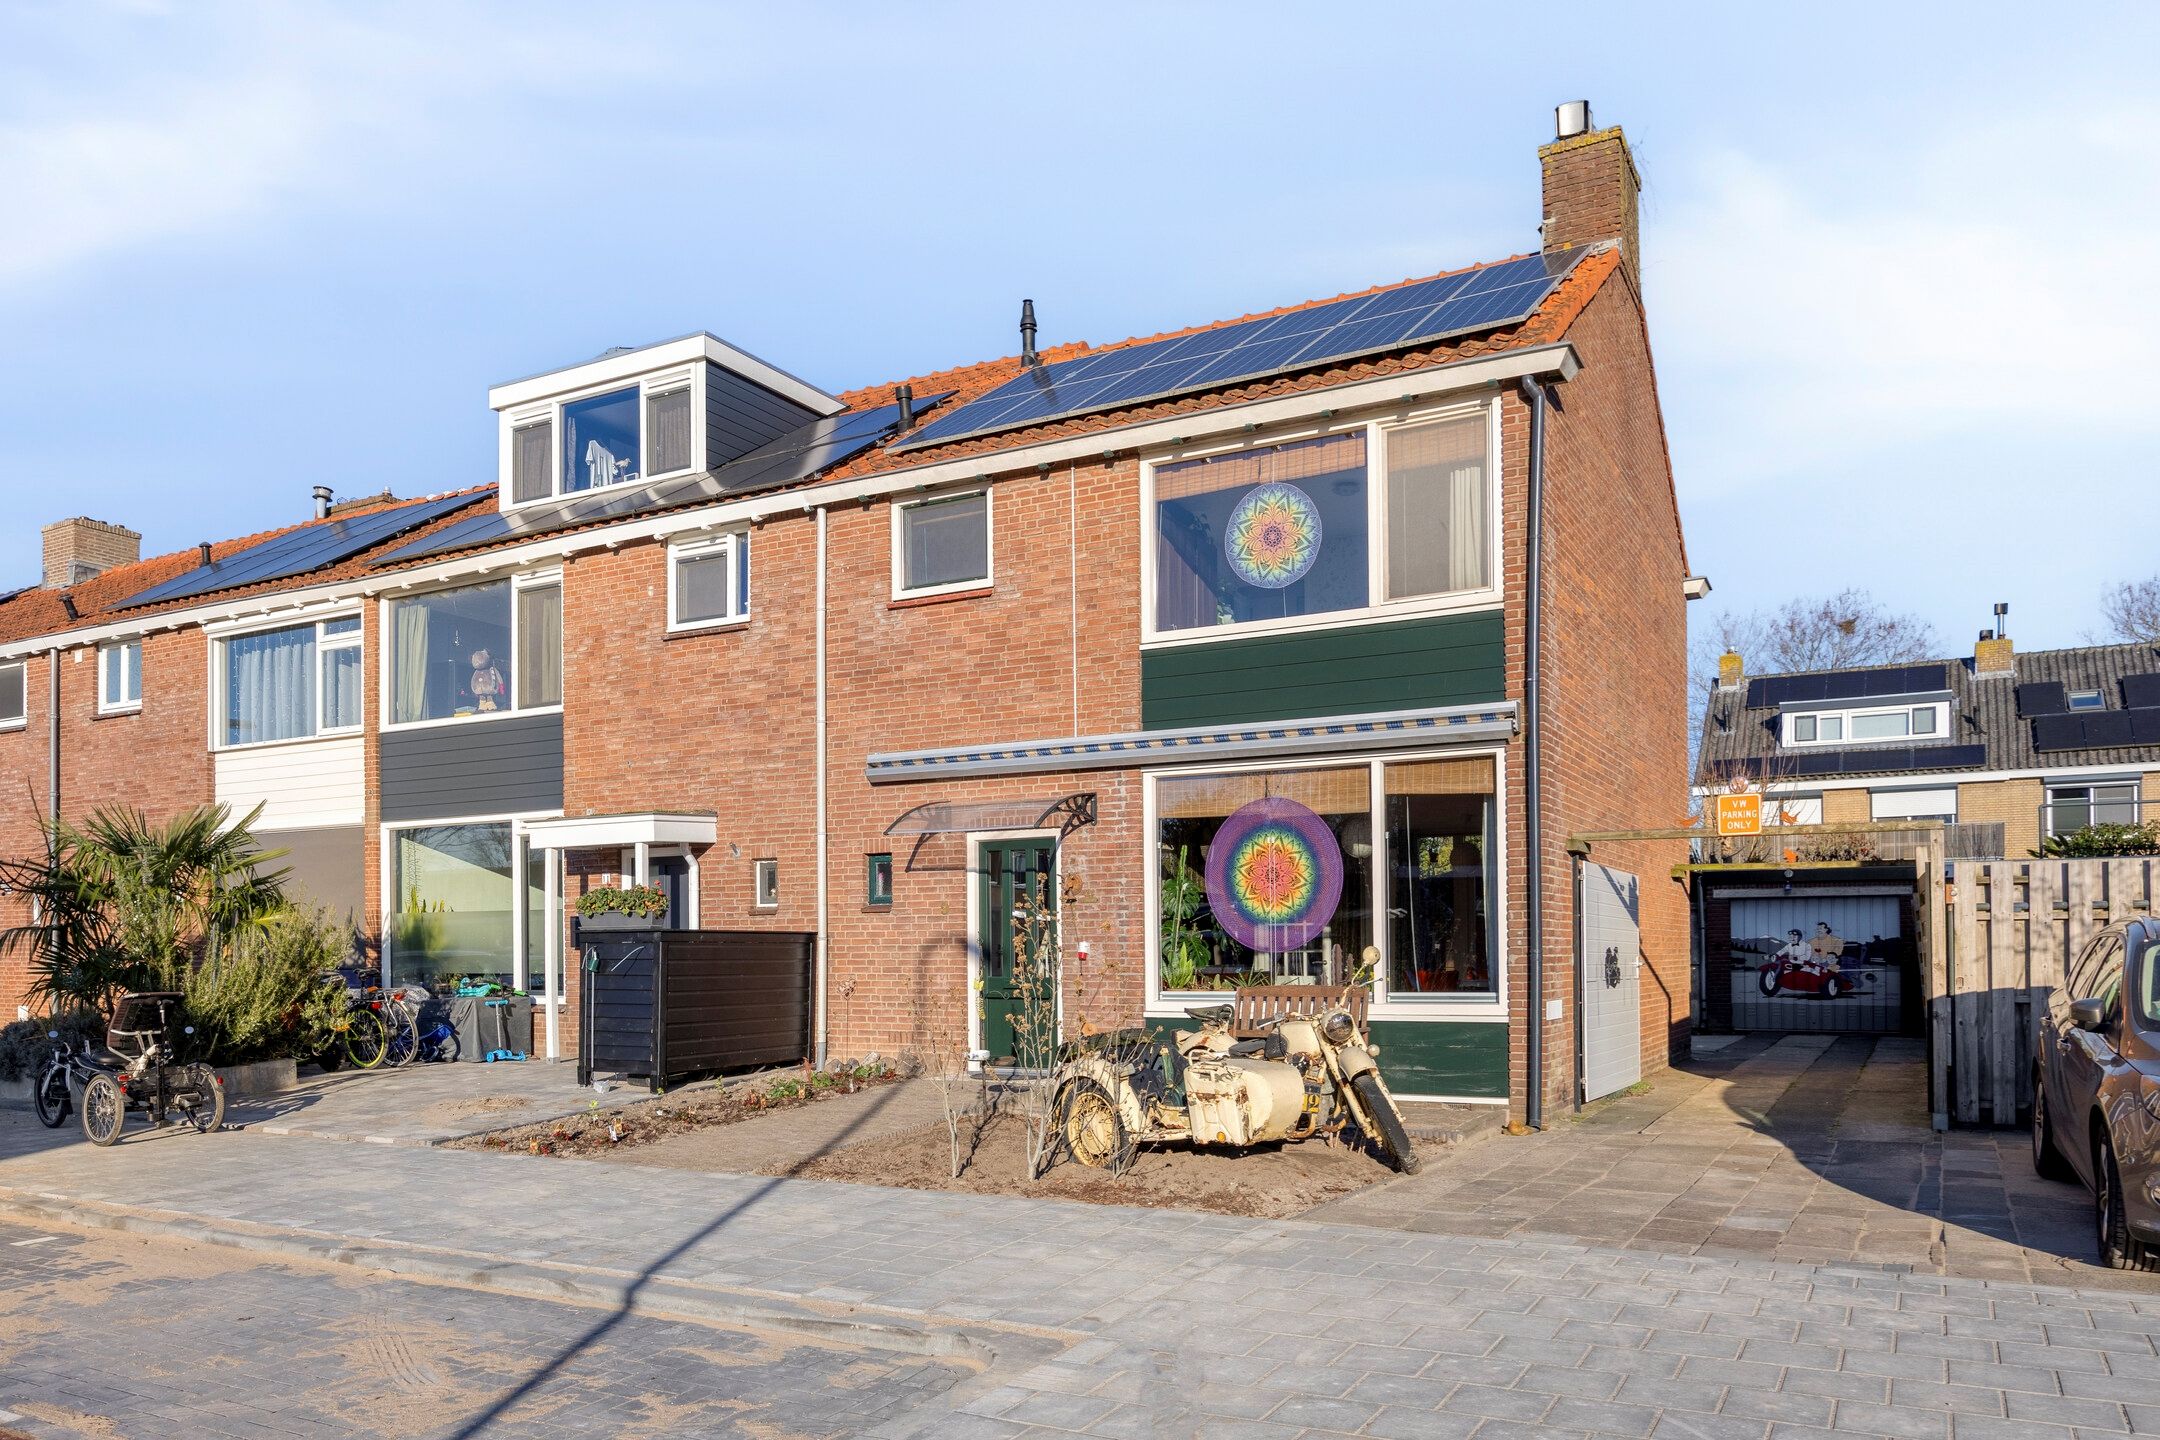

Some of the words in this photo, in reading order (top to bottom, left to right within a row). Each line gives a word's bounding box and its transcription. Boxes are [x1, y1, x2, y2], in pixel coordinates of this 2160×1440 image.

[1732, 800, 1747, 808] VW
[1722, 810, 1757, 819] PARKING
[1727, 821, 1752, 830] ONLY
